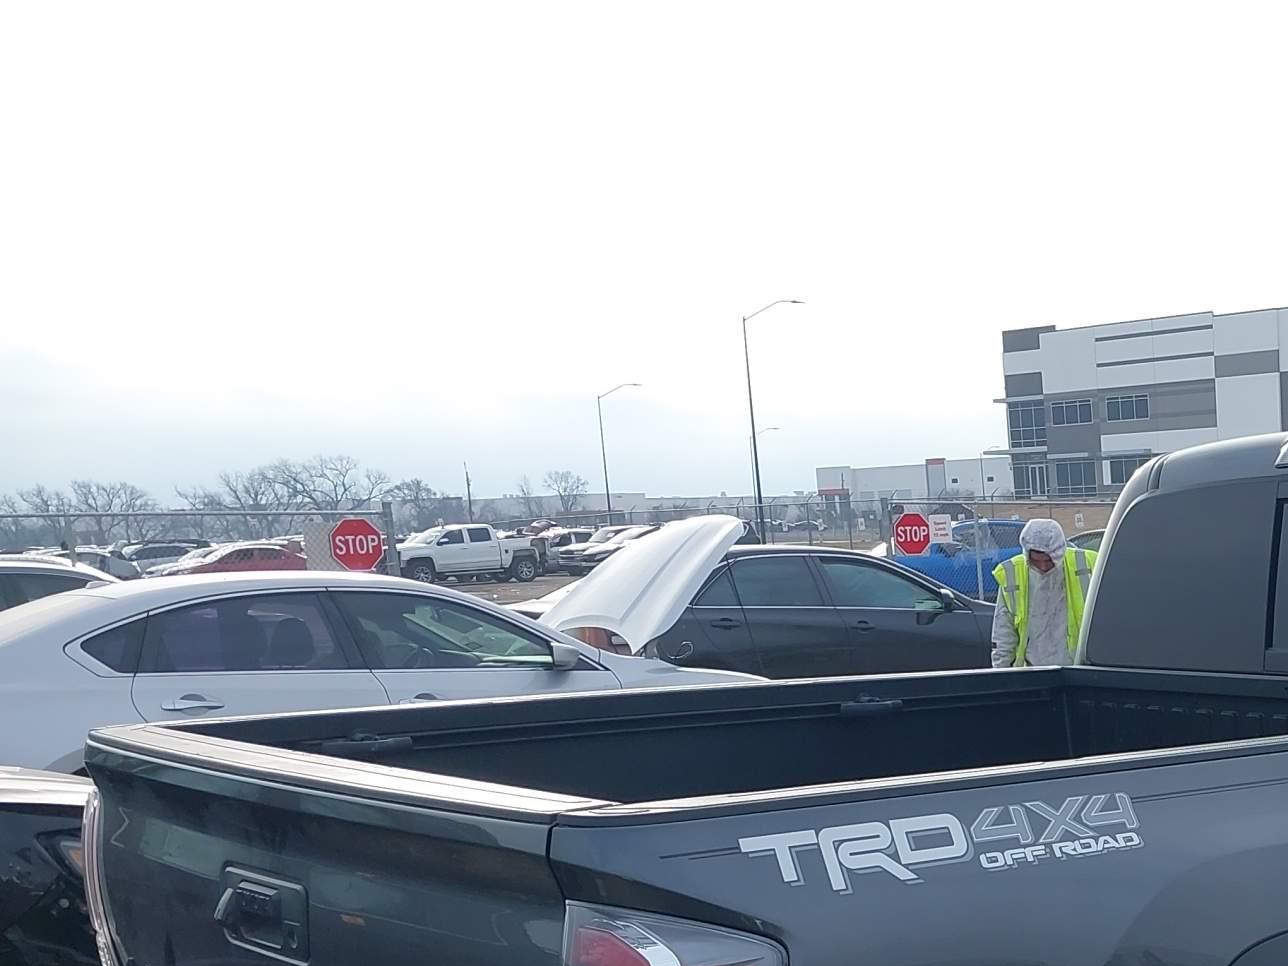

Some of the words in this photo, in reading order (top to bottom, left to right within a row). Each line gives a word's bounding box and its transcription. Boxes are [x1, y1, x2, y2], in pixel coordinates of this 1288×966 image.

[334, 534, 379, 555] STOP
[897, 526, 928, 542] STOP
[737, 813, 970, 892] TRD
[979, 844, 1046, 870] OFF
[1053, 831, 1142, 859] ROAD
